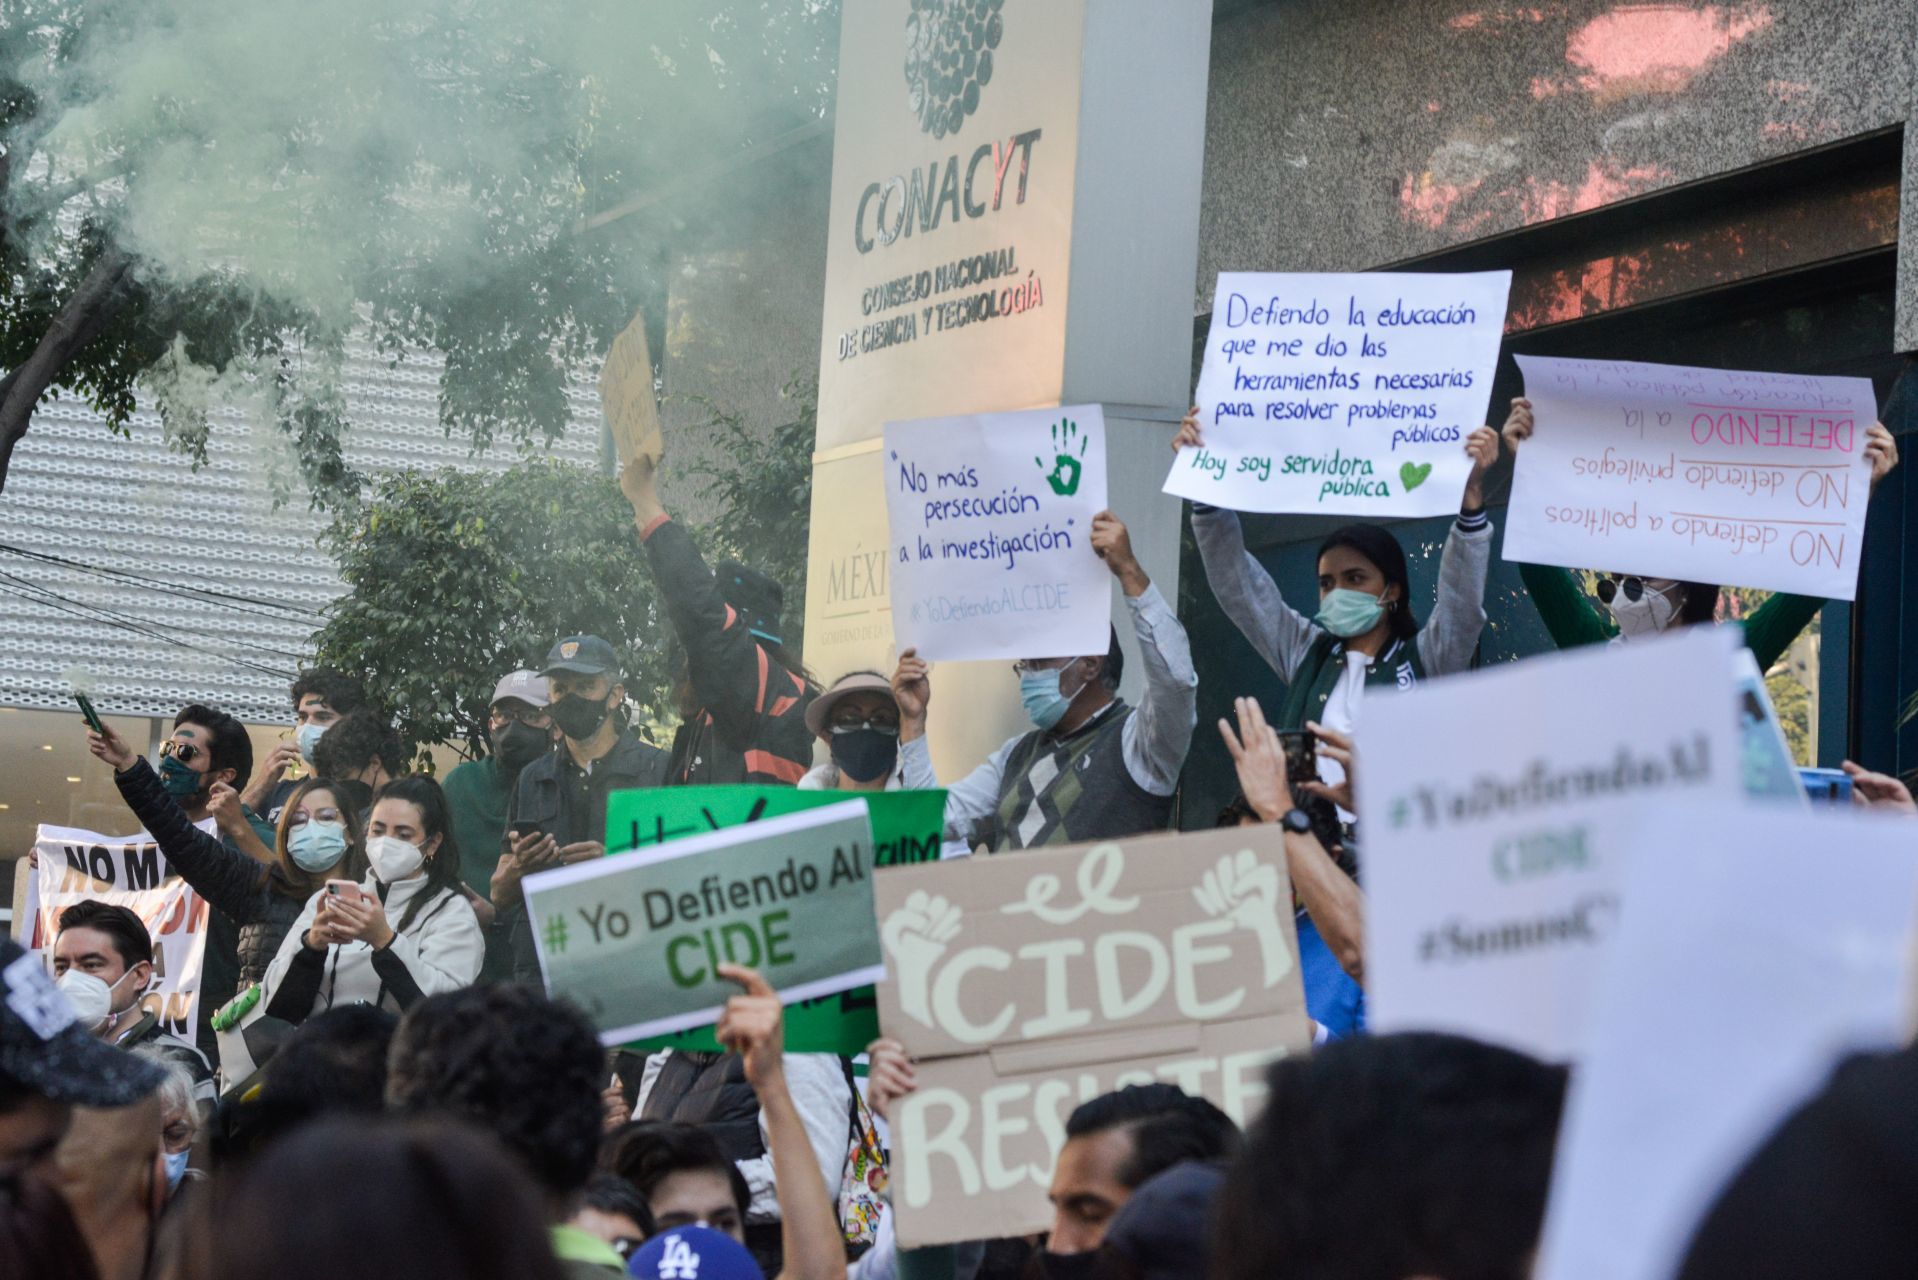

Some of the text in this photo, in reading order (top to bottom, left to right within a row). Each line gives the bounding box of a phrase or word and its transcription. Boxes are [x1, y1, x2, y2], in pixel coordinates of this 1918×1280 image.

[855, 128, 1042, 254] CONACYT
[862, 246, 1018, 316] CONSEJO NACIONAL
[838, 269, 1043, 362] DE CIENCIA Y TECNOLOGÍA
[1227, 293, 1475, 328] Defiendo la educación
[1222, 333, 1387, 363] que me dio las
[1234, 366, 1473, 391] herramientas necesarias
[1215, 398, 1437, 427] para resolver problemas
[1622, 406, 1853, 452] DEFIENDO a la
[1392, 424, 1460, 451] públicos
[938, 465, 979, 489] más
[1192, 448, 1373, 481] Hoy soy servidora
[1573, 446, 1848, 509] NO defiendo privilegios
[925, 487, 1040, 528] persecución
[1319, 475, 1390, 501] pública
[900, 546, 909, 563] a
[918, 535, 933, 561] la
[1545, 501, 1844, 569] NO defiendo a políticos
[826, 541, 887, 605] MÉXI
[60, 846, 116, 894] NO
[642, 858, 819, 931] Defiendo
[828, 842, 865, 888] Al
[1002, 842, 1141, 924] el
[664, 910, 796, 989] CIDE
[930, 918, 1247, 1045] CIDE
[657, 1234, 700, 1279] LA
